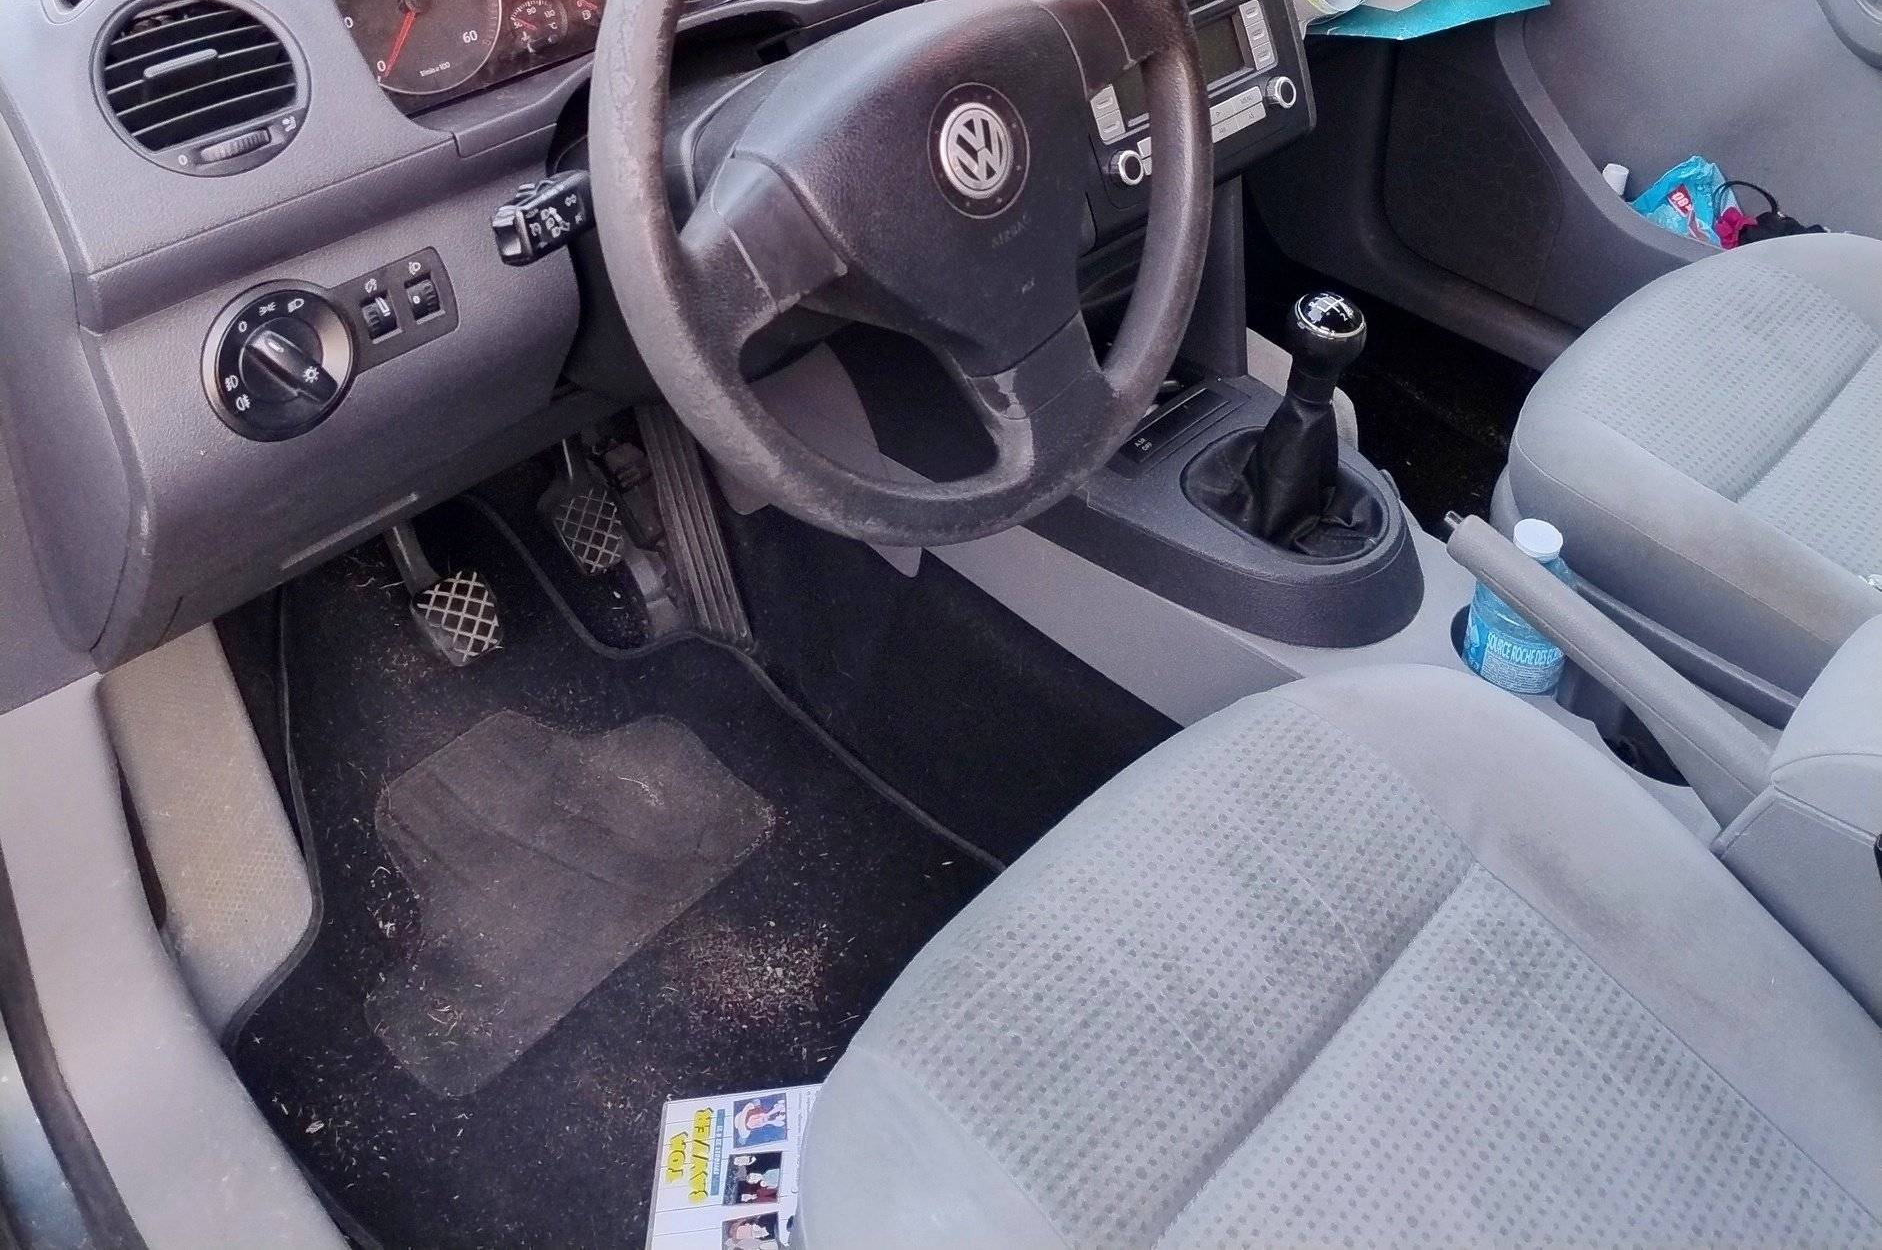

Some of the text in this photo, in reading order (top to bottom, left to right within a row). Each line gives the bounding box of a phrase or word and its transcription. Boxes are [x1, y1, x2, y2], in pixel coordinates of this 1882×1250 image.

[526, 6, 537, 15] 90
[344, 16, 354, 28] 0
[462, 30, 478, 43] 60
[377, 60, 387, 72] 0
[1487, 631, 1512, 660] SOURCE
[1509, 645, 1534, 664] ROCHE
[664, 1130, 689, 1183] TOM
[687, 1107, 714, 1206] SAWYER
